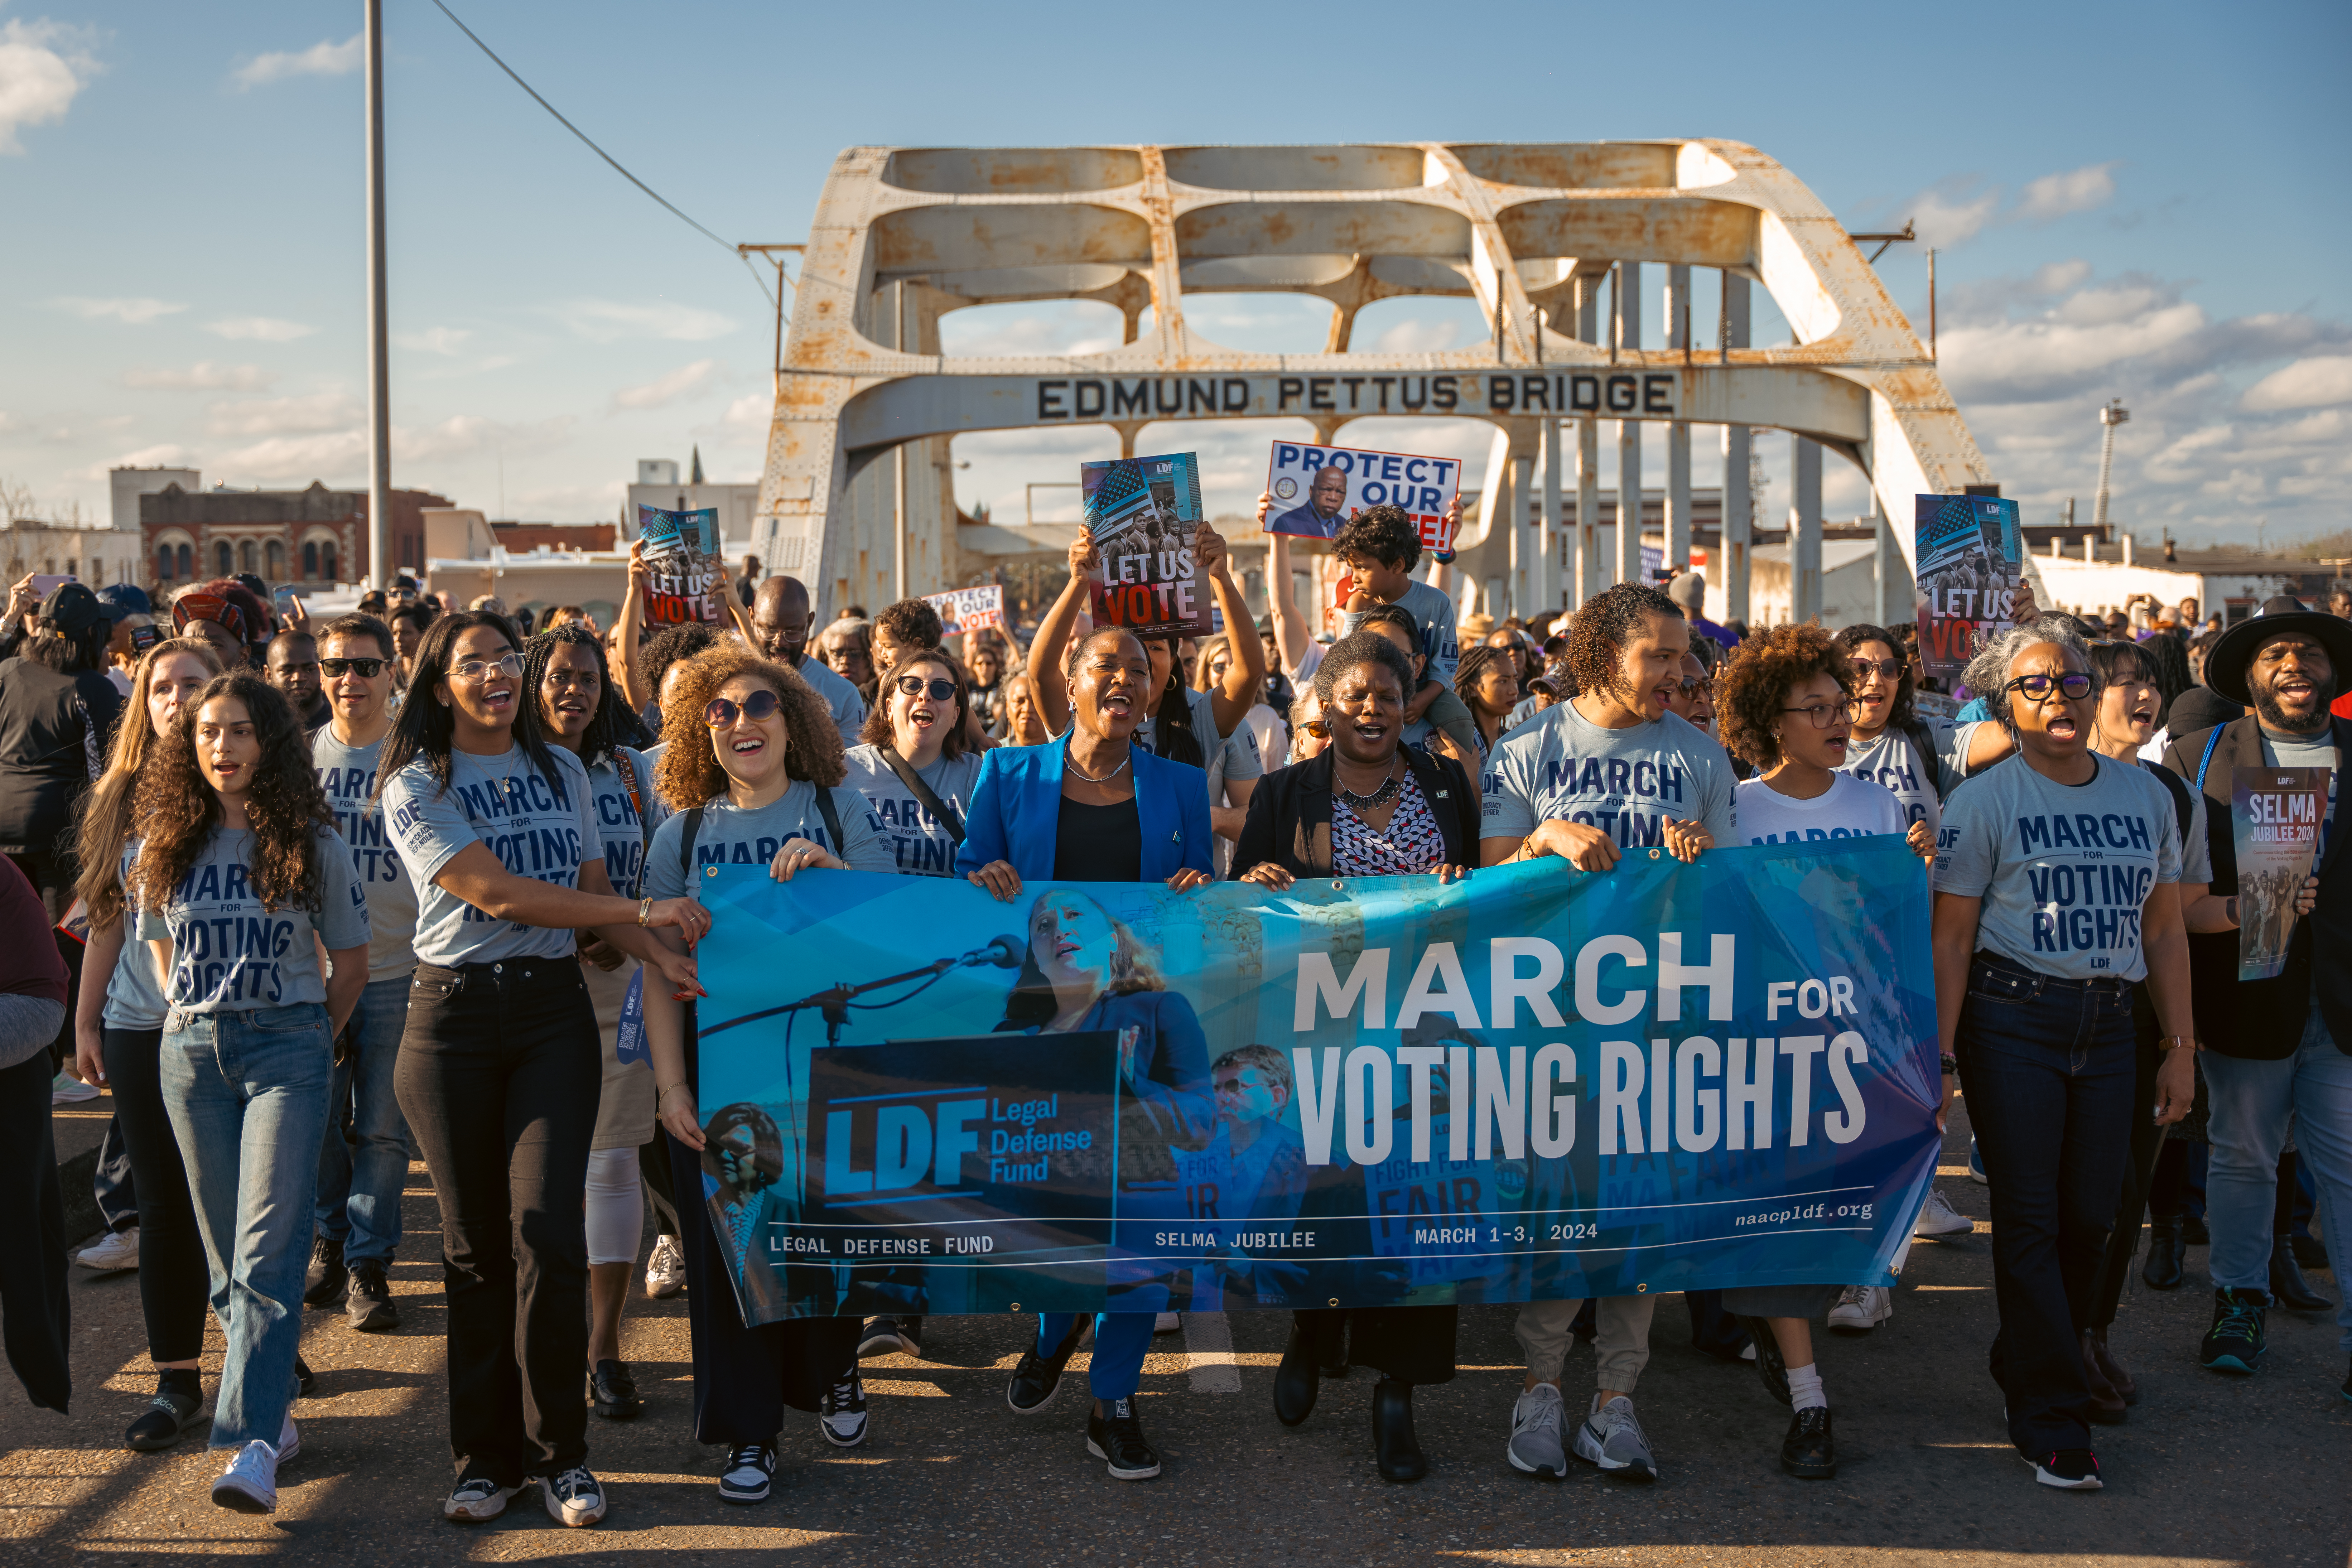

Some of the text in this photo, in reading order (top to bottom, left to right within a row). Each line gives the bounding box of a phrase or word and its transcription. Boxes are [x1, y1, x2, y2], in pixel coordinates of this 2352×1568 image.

[1038, 375, 1674, 419] EDMUND PETTUS BRIDGE
[1157, 463, 1173, 473] LDF
[1277, 445, 1454, 485] PROTECT
[1362, 481, 1442, 513] OUR
[1986, 505, 2000, 514] LDF
[1102, 549, 1195, 587] LET US
[651, 572, 714, 595] LET US
[651, 593, 718, 623] VOTE
[962, 599, 994, 613] OUR
[1104, 580, 1198, 626] VOTE
[1932, 588, 2014, 619] LET US
[1441, 642, 1459, 659] LD
[1482, 773, 1505, 795] DF
[1547, 757, 1682, 803] MARCH
[457, 774, 572, 821] MARCH
[1606, 798, 1626, 806] FOR
[2250, 794, 2316, 823] SELMA
[393, 798, 421, 838] LDF
[511, 817, 531, 828] FOR
[408, 825, 432, 850] DEMOCRACY
[411, 833, 435, 855] DEFENDER
[1936, 828, 1960, 849] DF
[2018, 814, 2152, 855] MARCH
[2250, 825, 2314, 841] JUBILEE 2024
[169, 864, 272, 906] MAR
[2027, 864, 2153, 909] VOTING
[221, 903, 241, 912] FOR
[171, 918, 294, 961] VOTING
[2033, 908, 2139, 952] RIGHTS
[2090, 958, 2110, 968] LDF
[177, 961, 282, 1003] RIGHTS
[1293, 932, 1859, 1032] MARCH FOR
[626, 996, 635, 1015] LDF
[993, 1093, 1057, 1126] Legal
[1292, 1031, 1868, 1165] VOTING RIGHTS
[991, 1127, 1092, 1155] Defense
[1435, 1124, 1450, 1135] LD
[825, 1099, 987, 1195] LDF
[991, 1155, 1048, 1183] Fund
[1375, 1156, 1431, 1184] FIGHT
[1378, 1176, 1484, 1238] FAIR
[1735, 1203, 1873, 1226] naacpldf.org
[770, 1235, 993, 1254] LEGAL DEFENSE FUND
[1155, 1232, 1315, 1248] SELMA JUBILEE
[1415, 1224, 1597, 1244] MARCH 1-3, 2024
[150, 1397, 177, 1414] adidas
